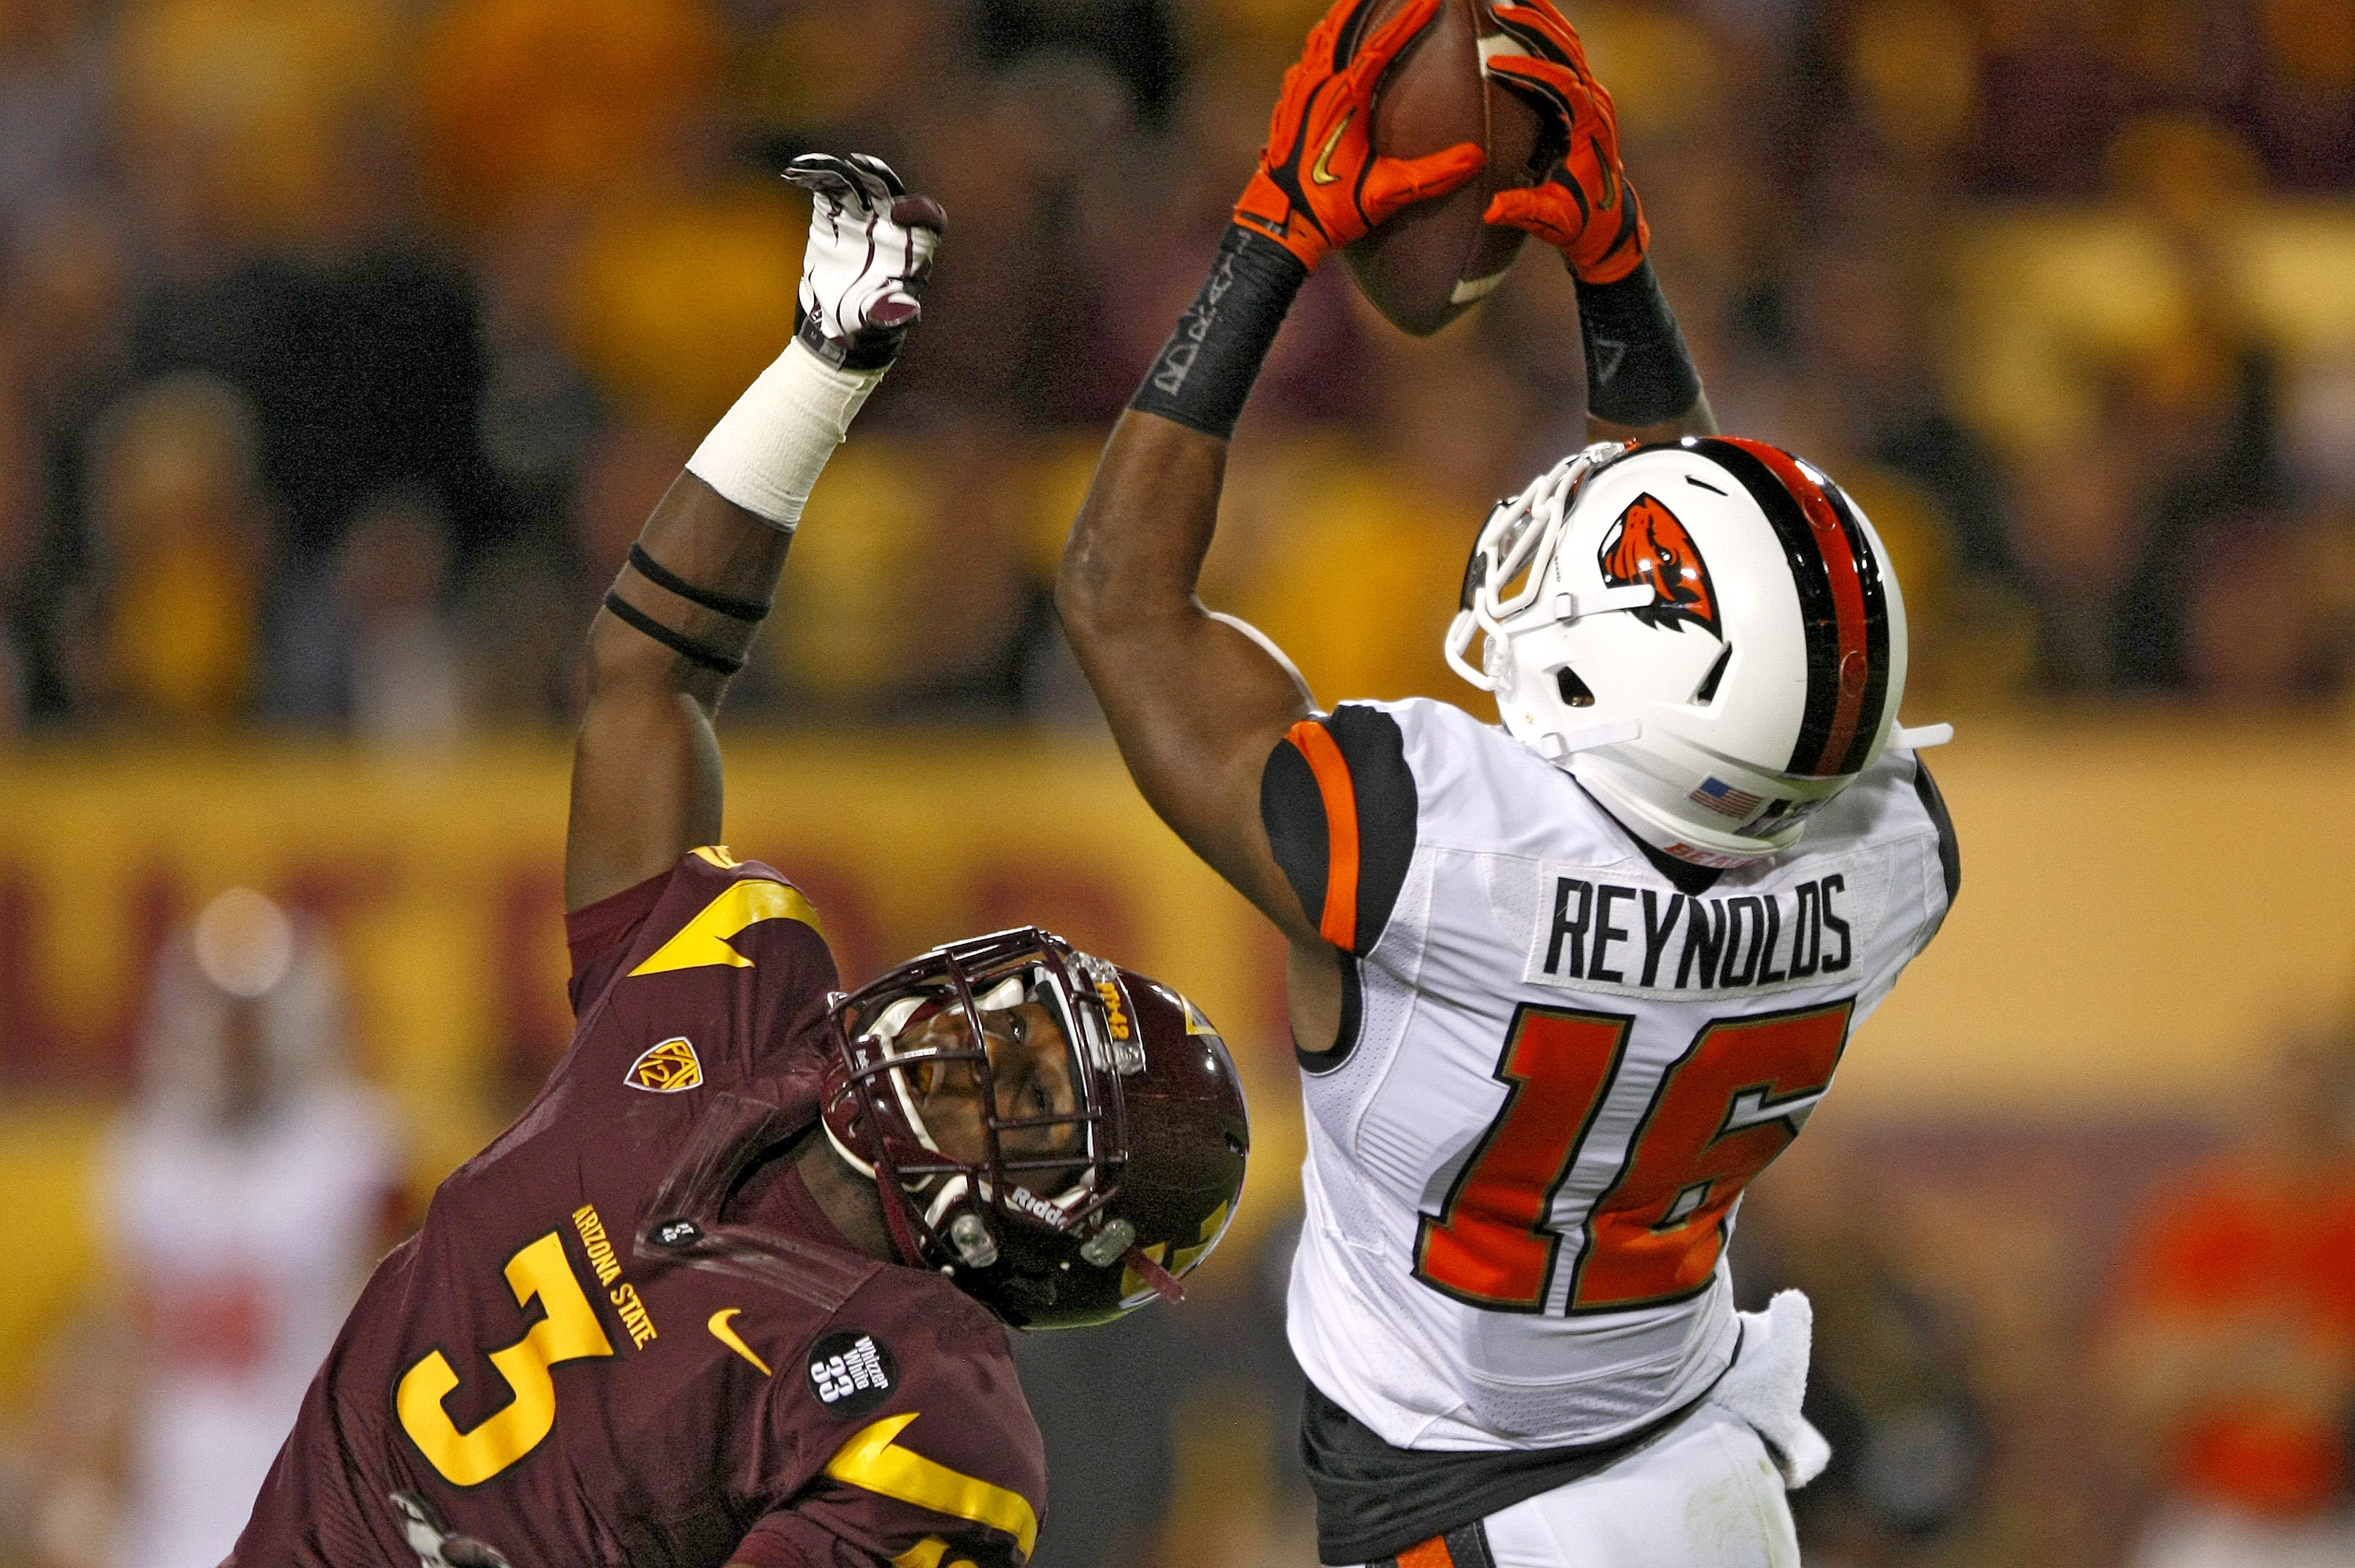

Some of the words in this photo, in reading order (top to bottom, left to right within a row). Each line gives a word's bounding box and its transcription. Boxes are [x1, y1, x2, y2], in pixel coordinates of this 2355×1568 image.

[1543, 873, 1852, 990] REYNOLDS
[637, 1059, 670, 1087] 12
[1412, 994, 1857, 1318] 16
[1011, 1186, 1068, 1227] Ridd
[571, 1203, 623, 1288] ARIZONA
[610, 1282, 658, 1351] STATE
[395, 1229, 616, 1488] 3
[810, 1355, 854, 1403] 33
[842, 1348, 870, 1391] White
[854, 1335, 889, 1389] Whizzer
